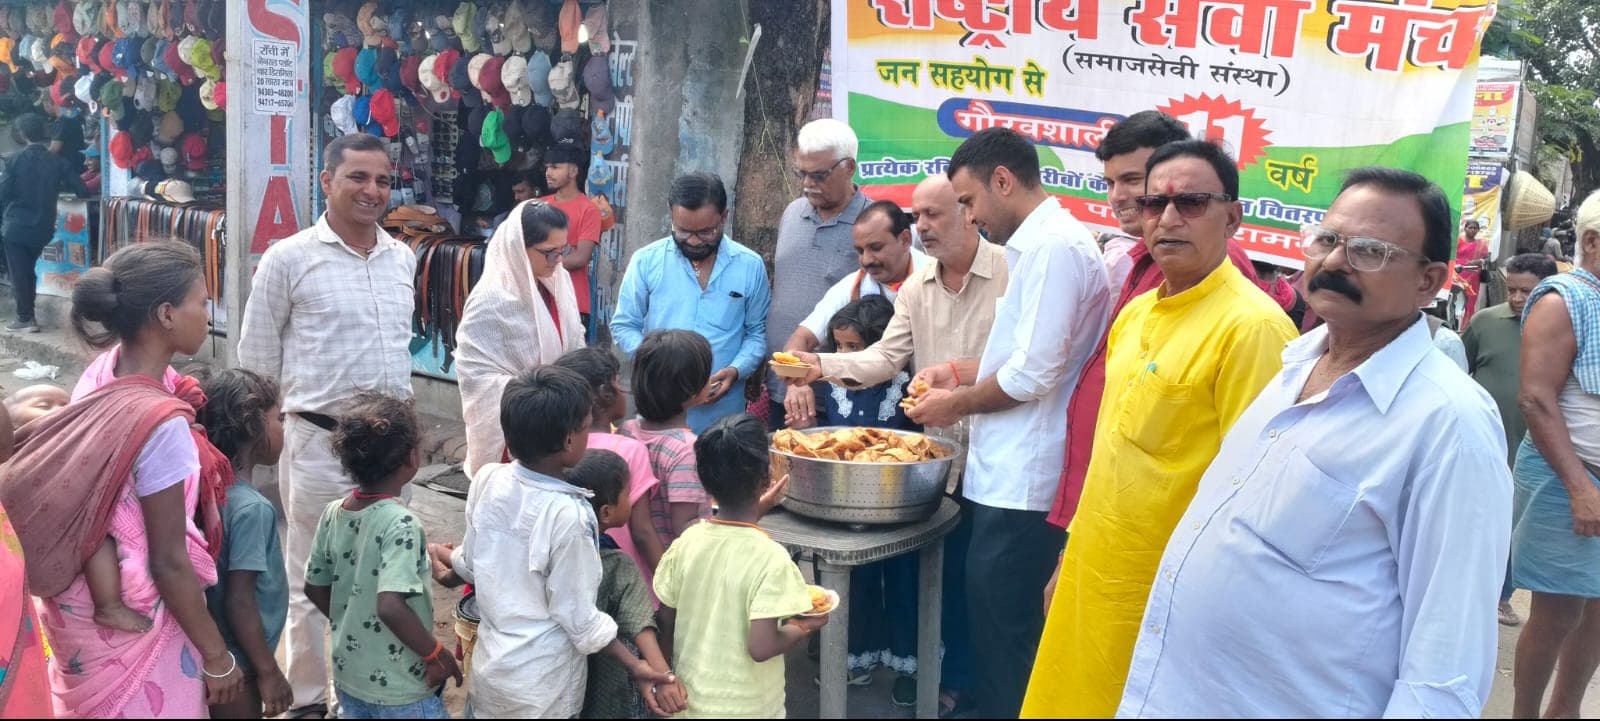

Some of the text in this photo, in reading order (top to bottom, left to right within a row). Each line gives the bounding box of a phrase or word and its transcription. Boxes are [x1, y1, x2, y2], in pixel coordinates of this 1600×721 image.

[876, 56, 1045, 95] जन सहयोग से
[1177, 109, 1246, 163] 11
[859, 158, 919, 177] प्रत्येक
[1039, 167, 1084, 188] रीबों
[1267, 155, 1316, 192] वर्ष
